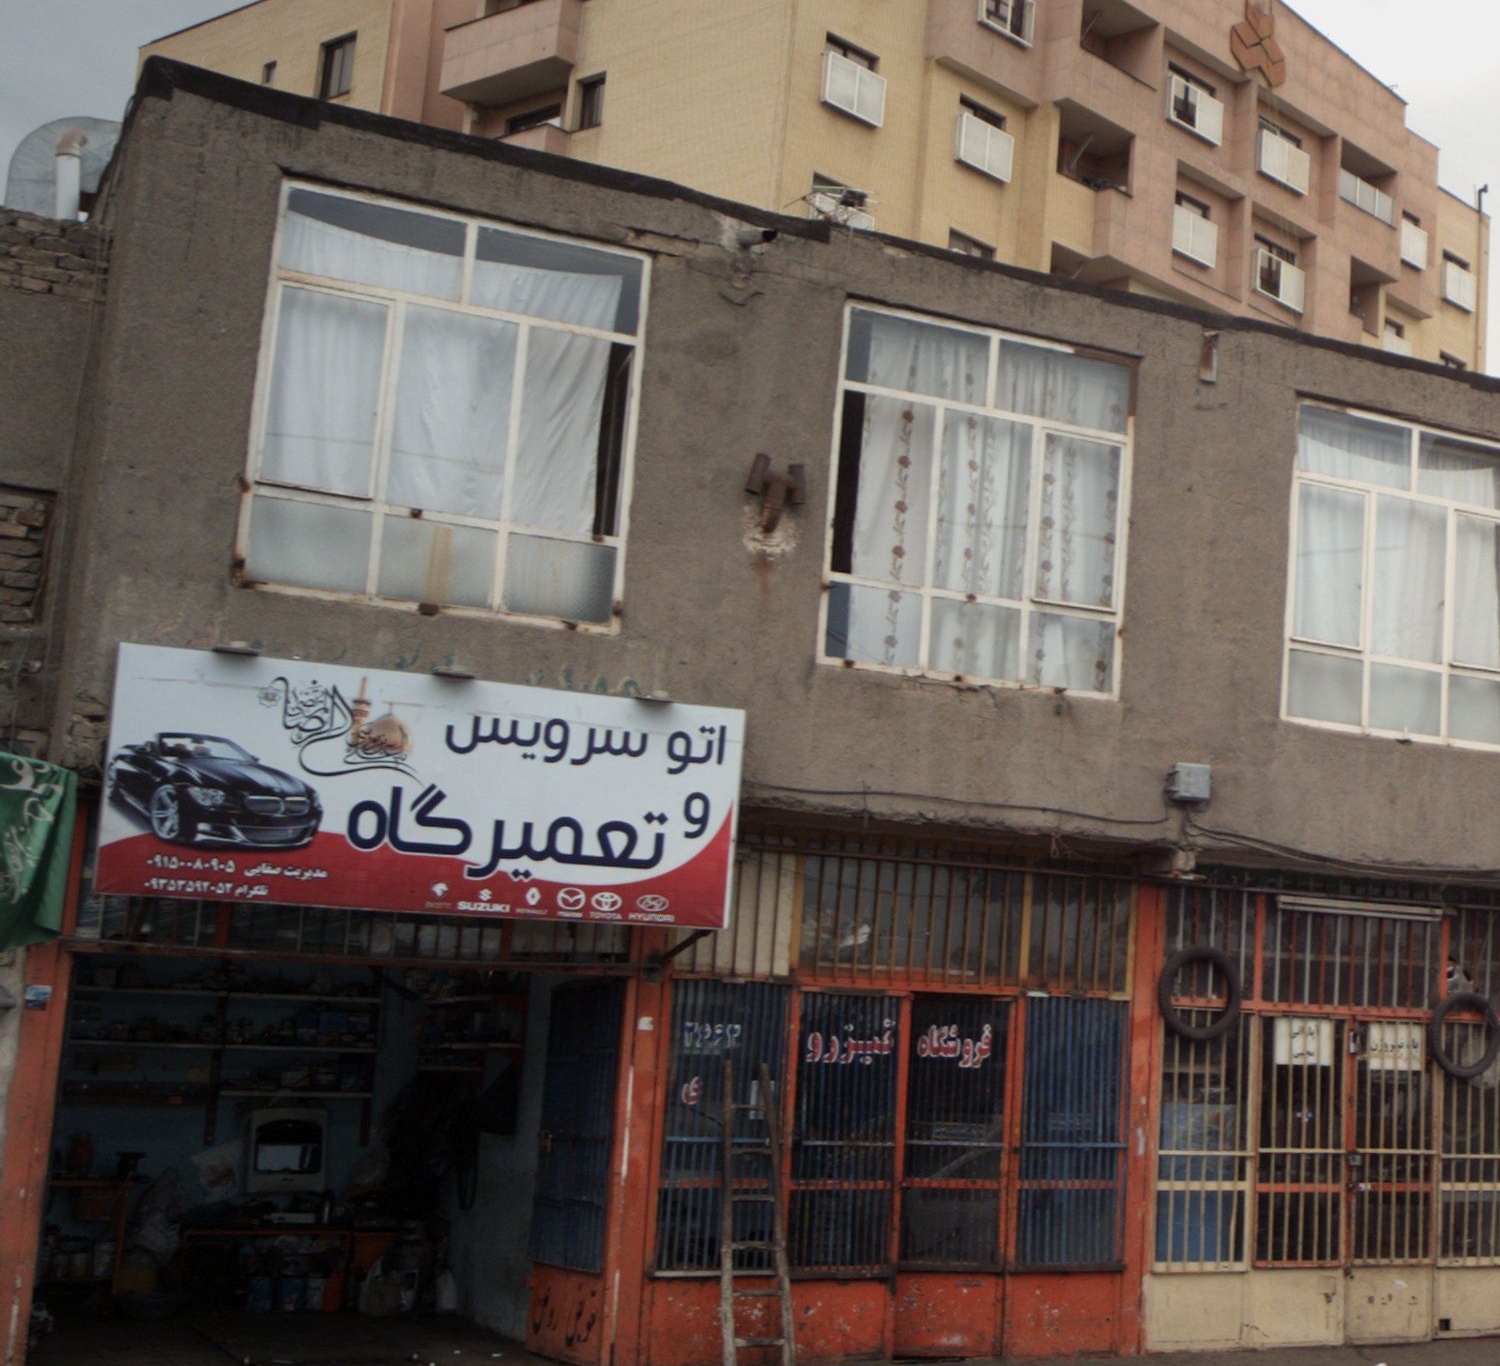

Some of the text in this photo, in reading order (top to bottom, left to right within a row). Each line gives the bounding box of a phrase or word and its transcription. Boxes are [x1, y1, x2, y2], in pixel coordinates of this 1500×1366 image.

[445, 715, 648, 766] سرویس
[666, 724, 727, 774] اتو
[346, 783, 711, 880] و تعمیرگاه
[283, 866, 328, 881] مدیریت
[457, 900, 511, 913] SUZUKI
[916, 1023, 992, 1069] فروشگاه
